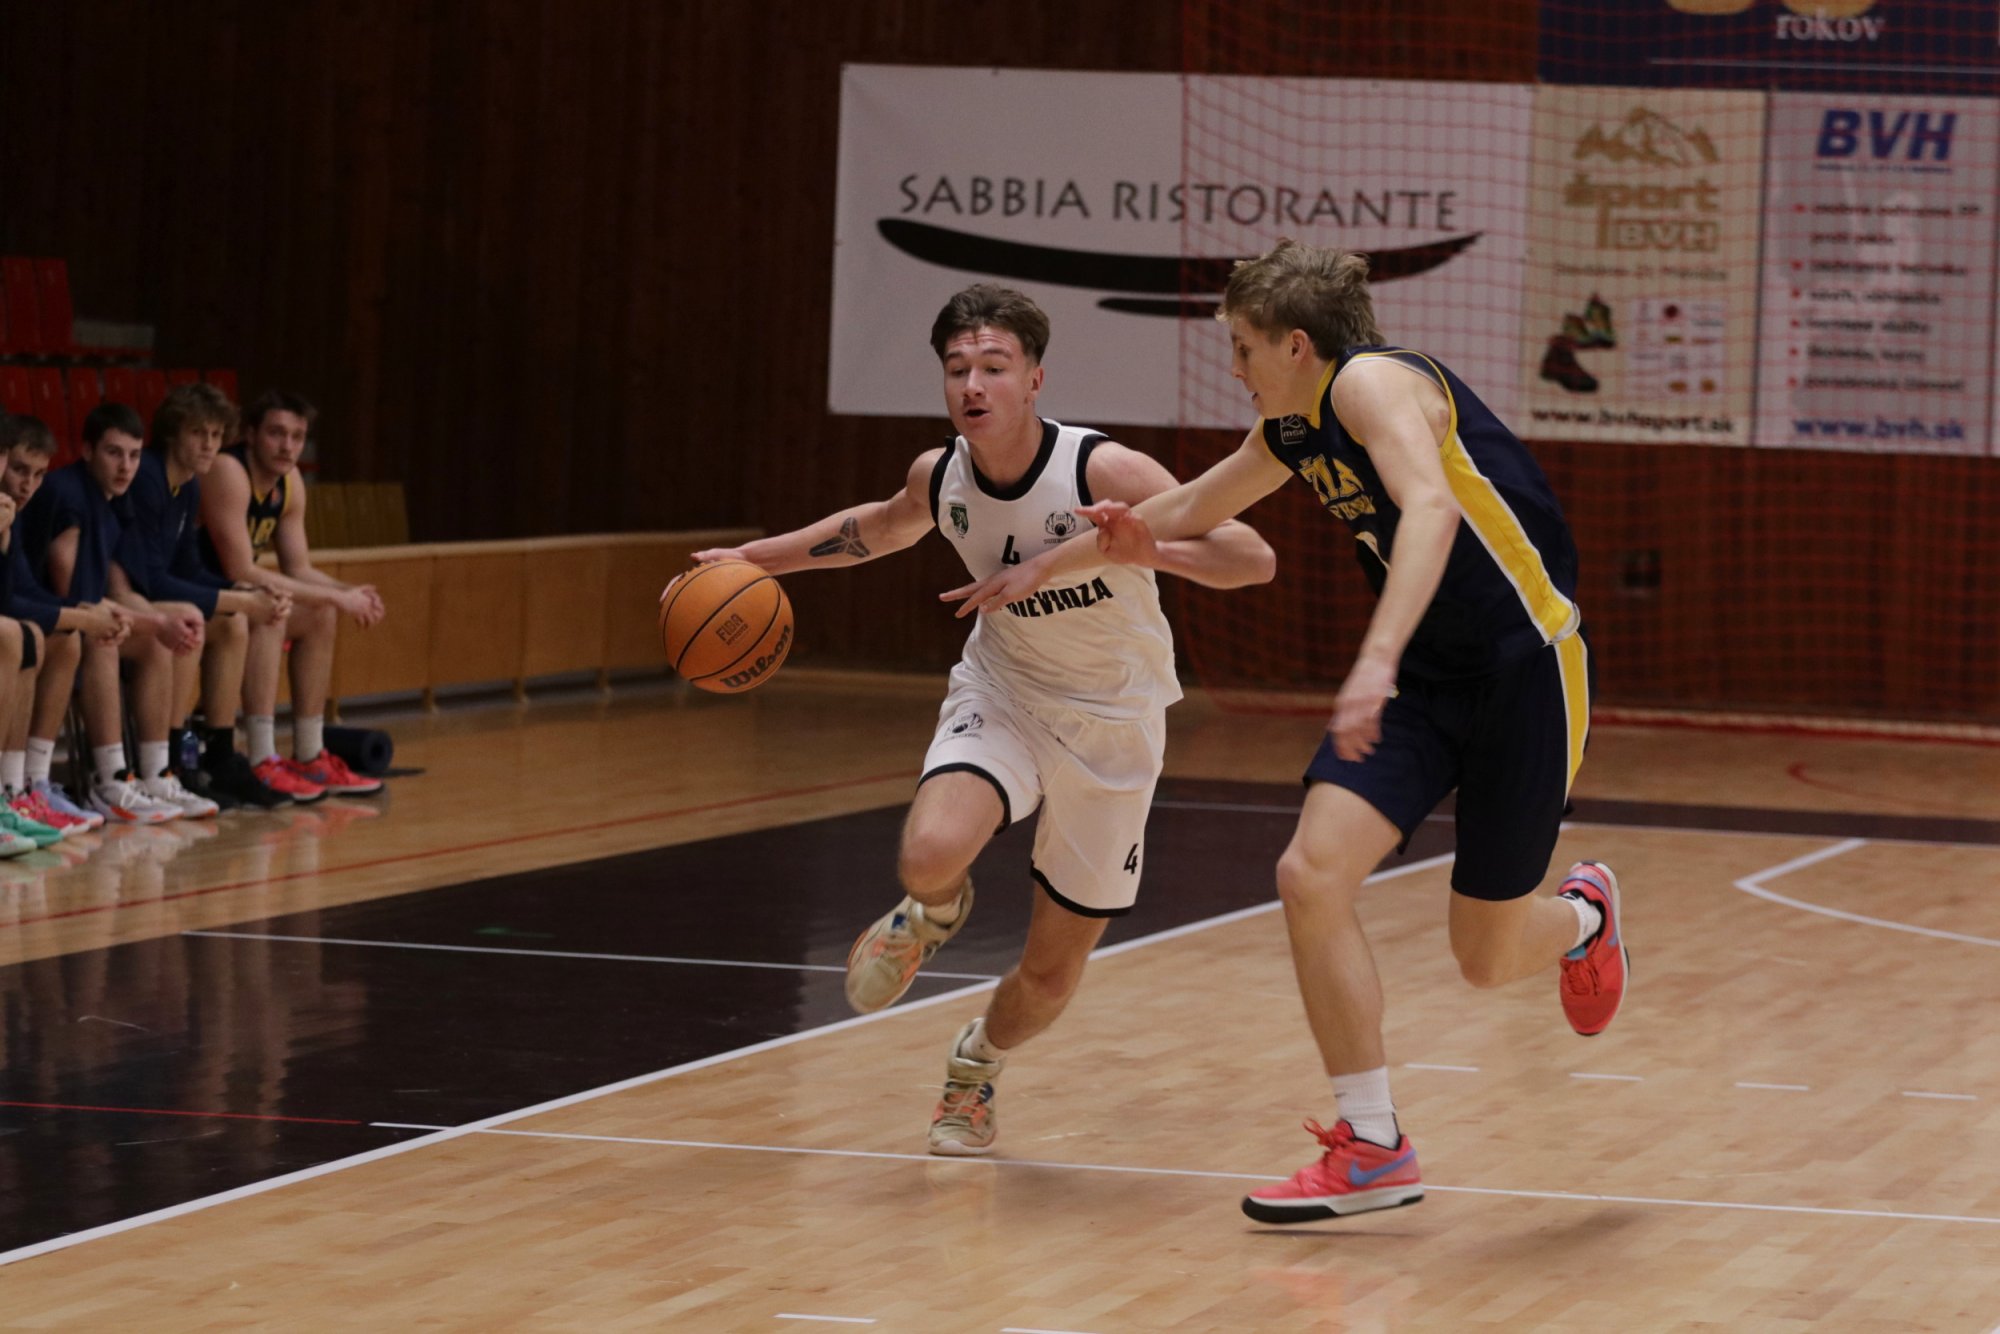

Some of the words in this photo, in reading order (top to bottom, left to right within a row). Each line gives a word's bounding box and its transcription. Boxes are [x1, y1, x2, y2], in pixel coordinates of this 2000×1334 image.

[1775, 11, 1885, 42] rokov
[1815, 109, 1957, 161] BVH
[899, 174, 1090, 219] SABBIA
[1112, 182, 1457, 232] RISTORANTE
[1615, 218, 1718, 251] BVH
[1001, 535, 1021, 565] 4
[720, 624, 791, 688] Wilson
[1123, 843, 1139, 875] 4
